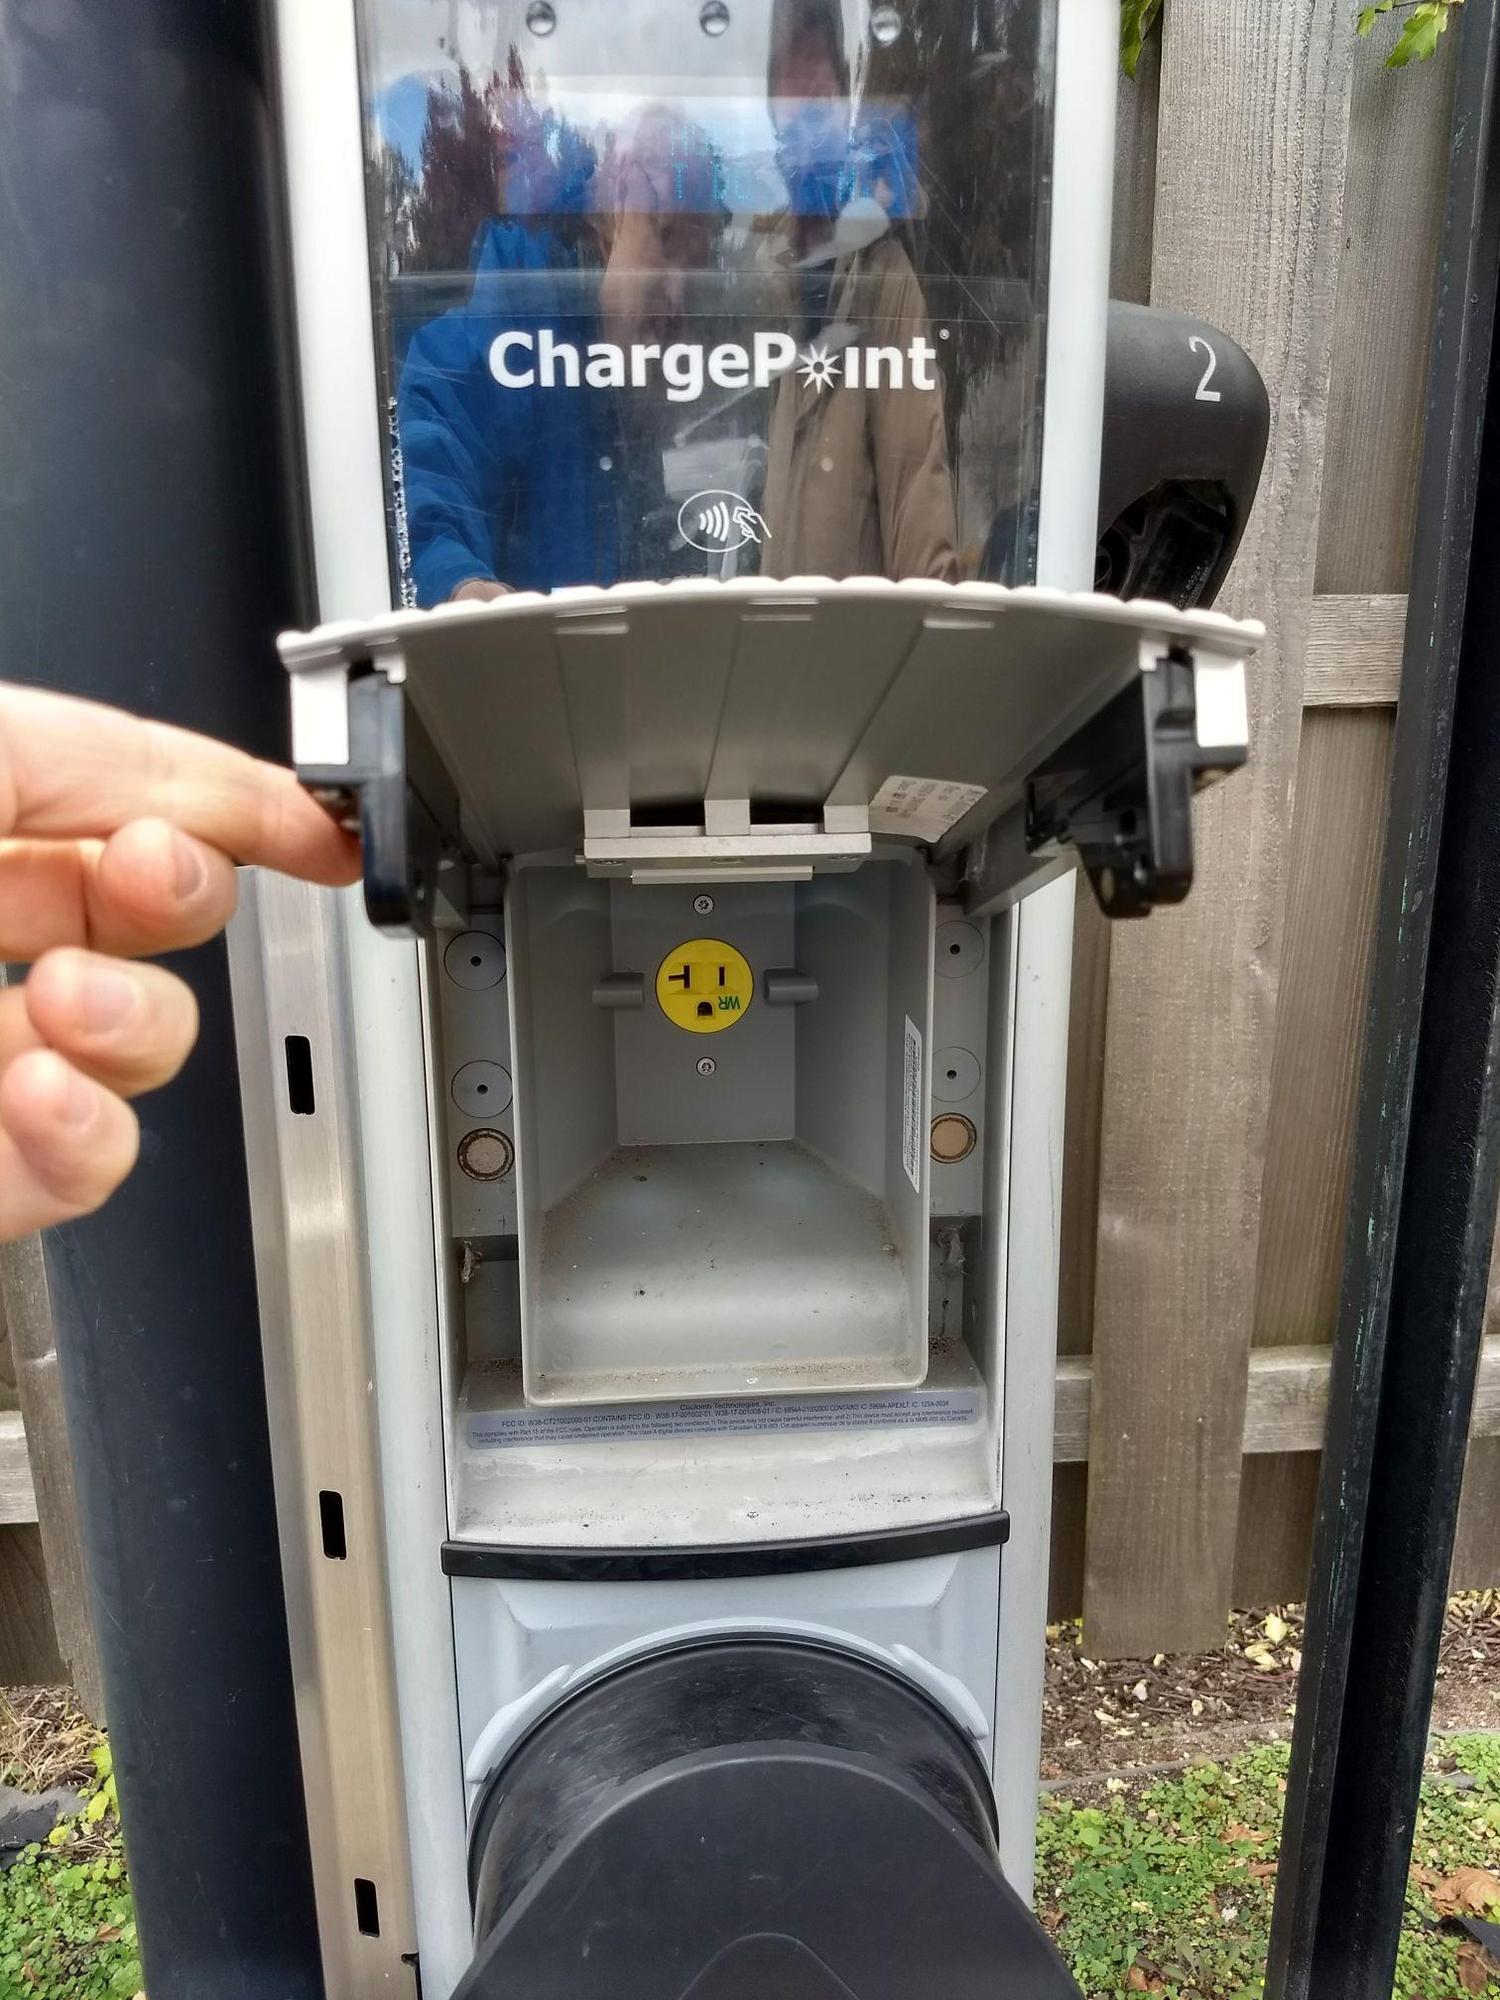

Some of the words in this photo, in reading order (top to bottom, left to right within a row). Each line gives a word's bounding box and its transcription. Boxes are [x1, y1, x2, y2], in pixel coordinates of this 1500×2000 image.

[489, 329, 937, 402] ChargePoint
[1188, 335, 1221, 402] 2
[718, 995, 741, 1010] WR
